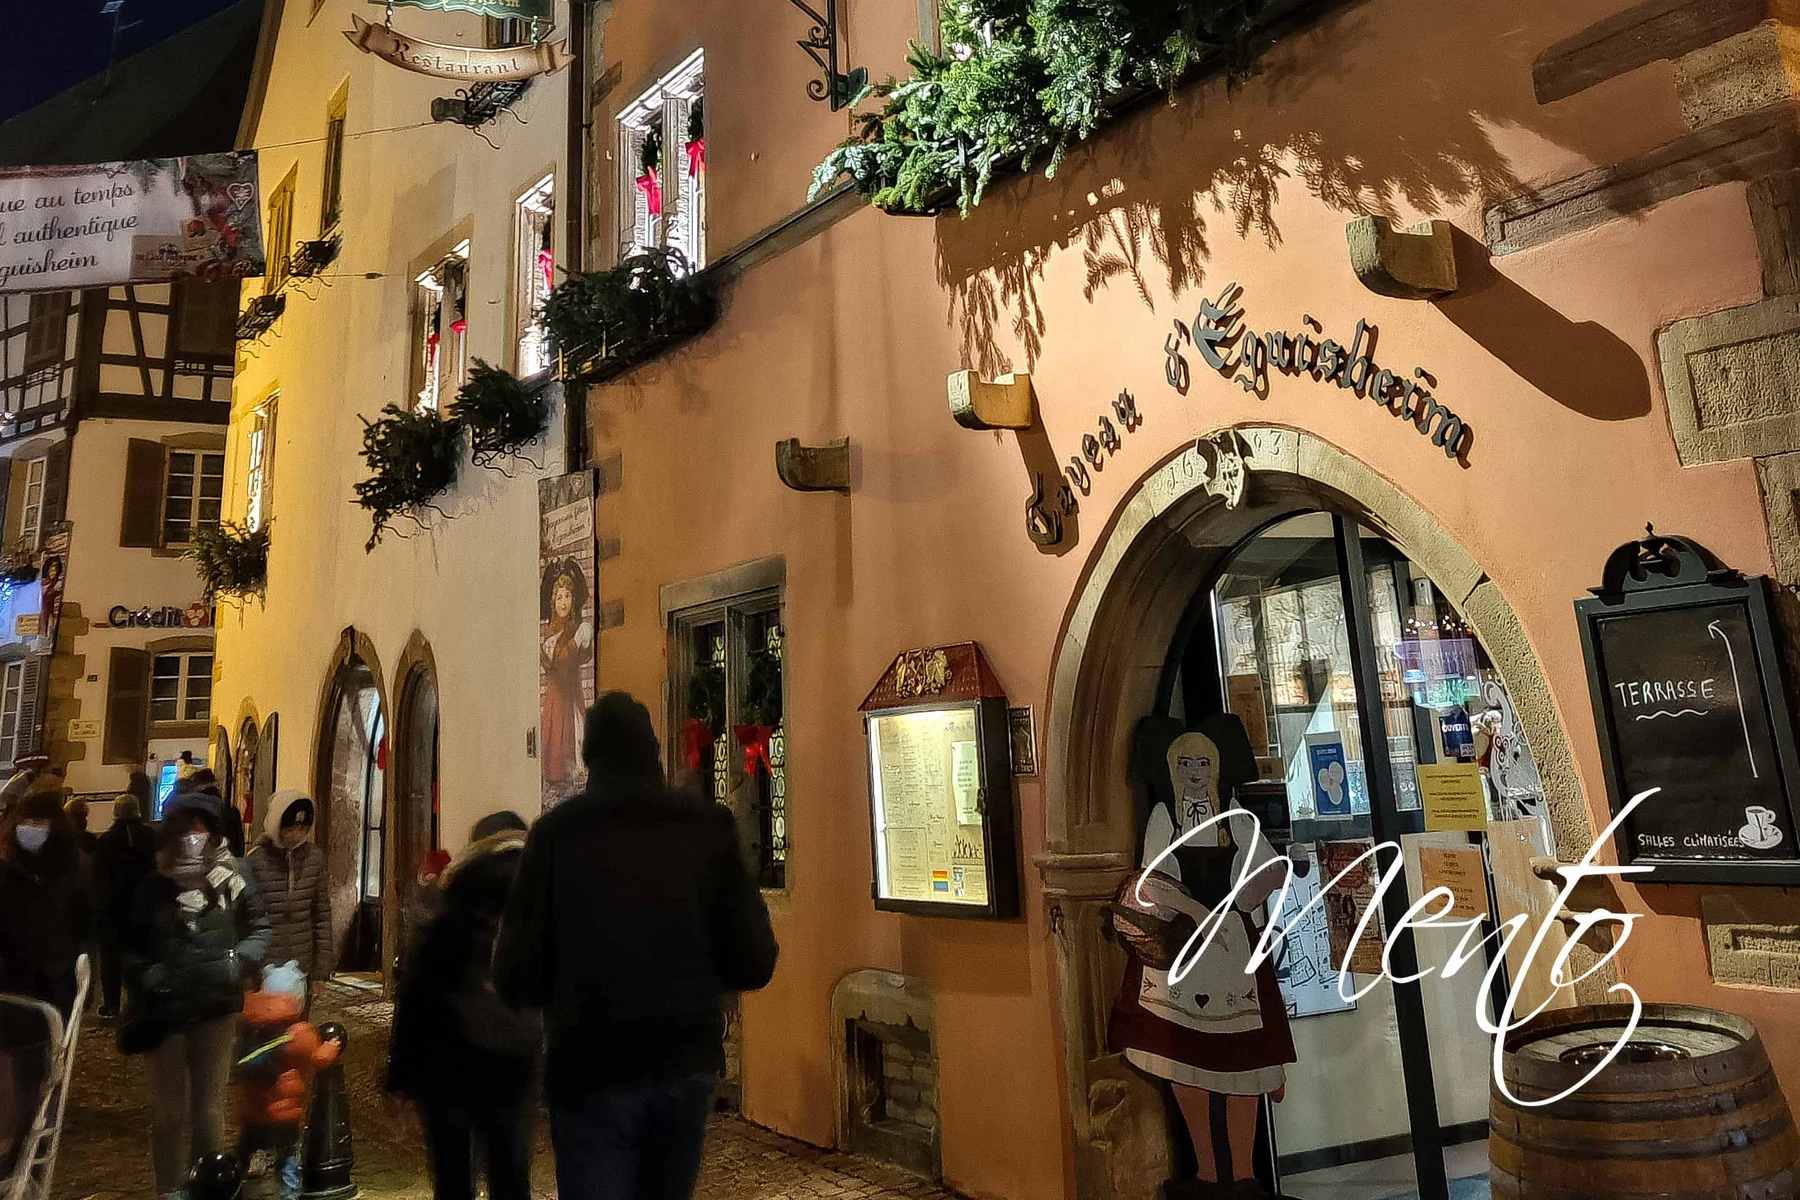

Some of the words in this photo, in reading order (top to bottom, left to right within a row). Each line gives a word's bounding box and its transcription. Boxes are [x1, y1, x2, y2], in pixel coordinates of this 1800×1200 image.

[389, 38, 521, 75] Restaurant
[34, 195, 66, 210] au
[74, 181, 134, 208] temps
[13, 215, 139, 242] authentique
[108, 604, 184, 629] Crédit
[1614, 679, 1715, 708] TERRASSE
